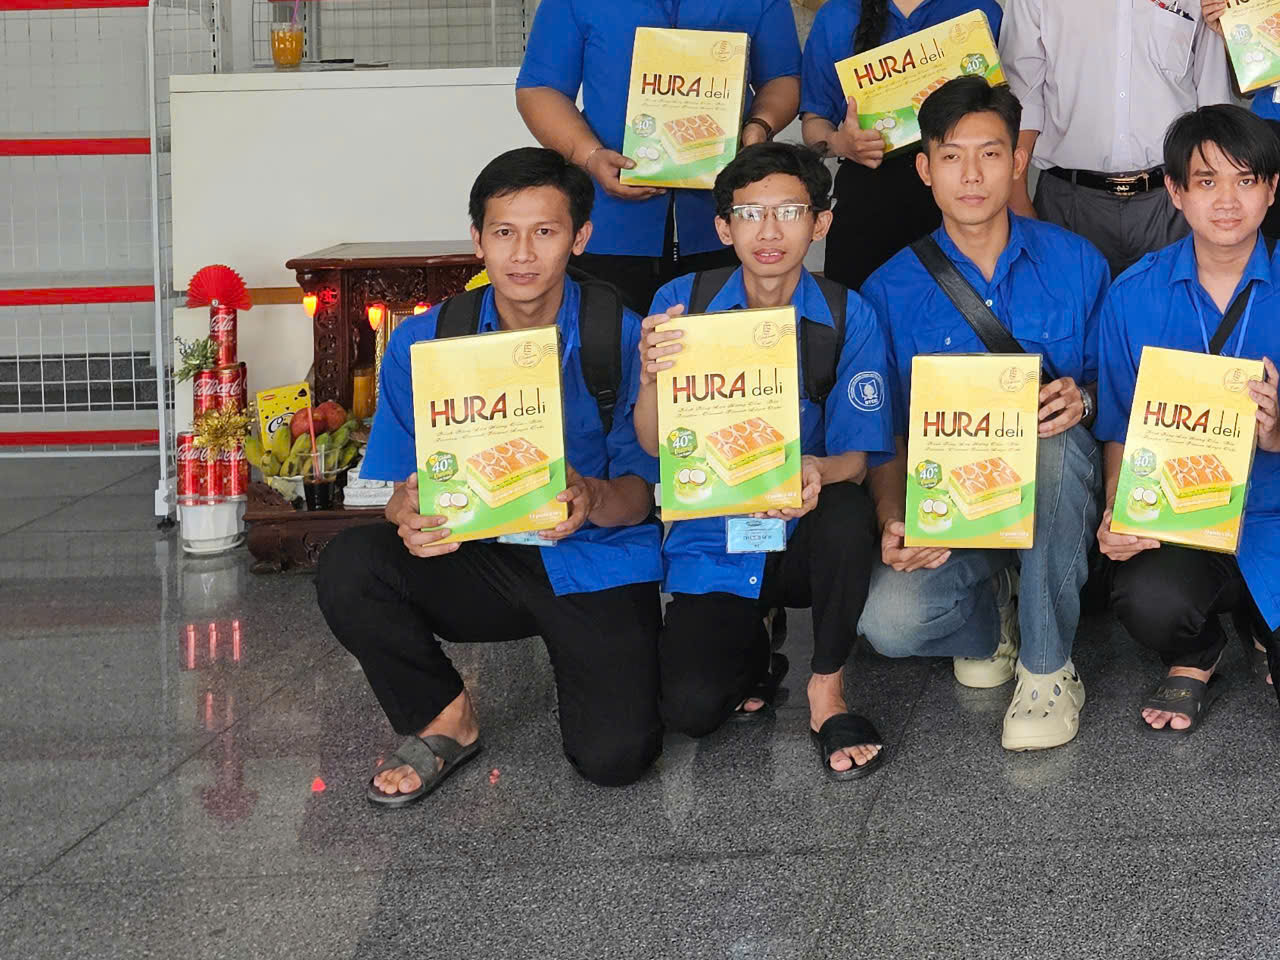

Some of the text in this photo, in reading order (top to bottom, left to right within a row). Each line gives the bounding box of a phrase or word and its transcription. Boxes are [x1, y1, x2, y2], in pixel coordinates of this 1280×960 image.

[854, 48, 916, 89] HURA
[919, 38, 945, 65] deli
[641, 73, 730, 99] HURA deli
[672, 367, 782, 404] HURA deli
[430, 387, 546, 428] HURA deli
[923, 411, 1024, 438] HURA deli
[1144, 400, 1240, 438] HURA deli
